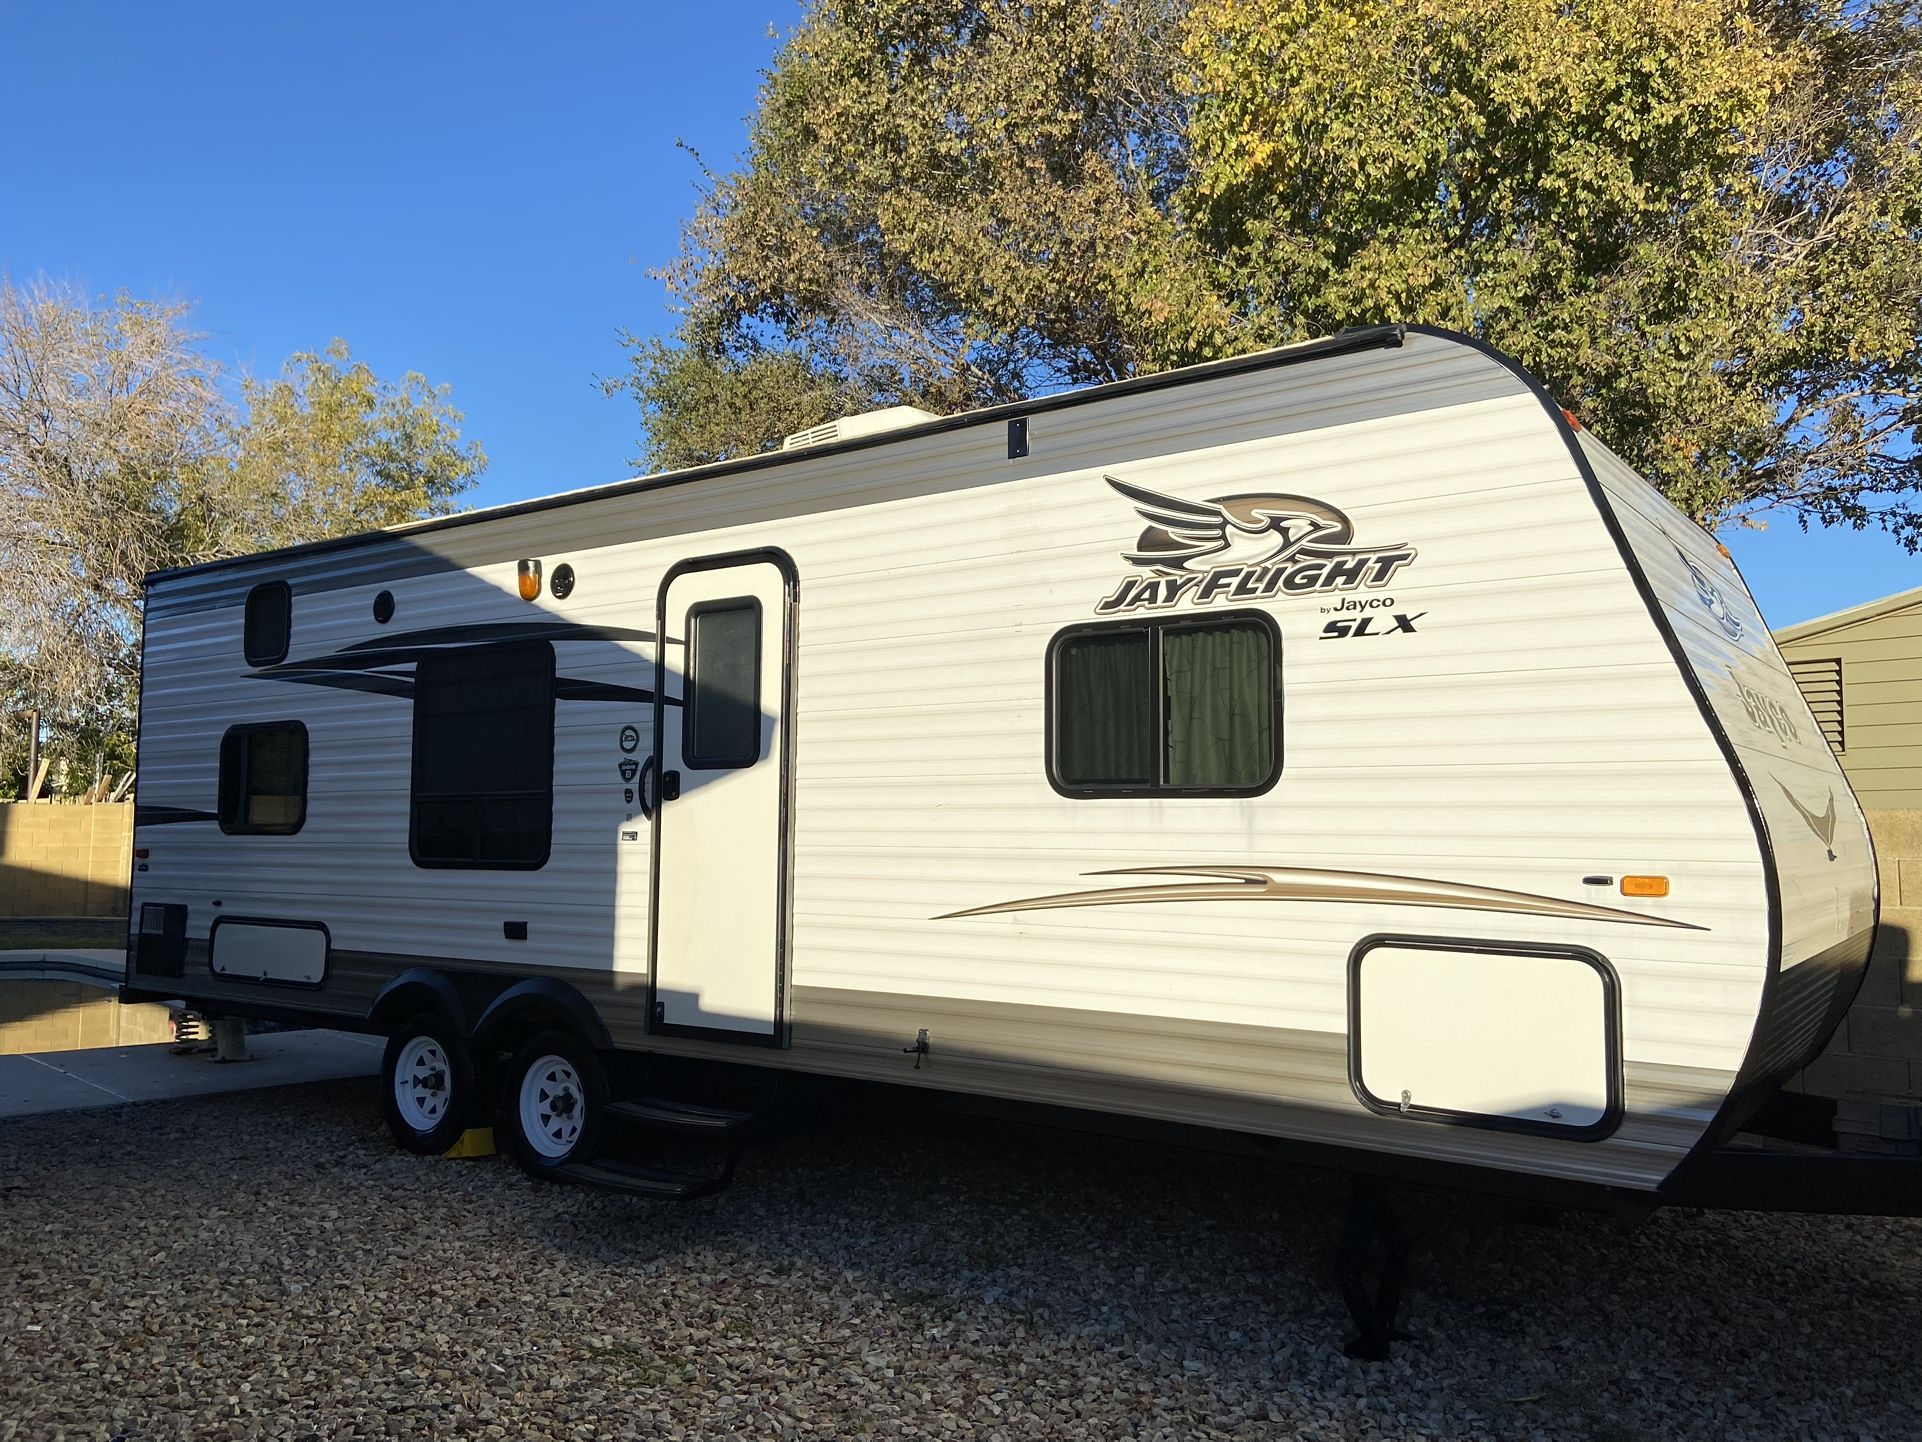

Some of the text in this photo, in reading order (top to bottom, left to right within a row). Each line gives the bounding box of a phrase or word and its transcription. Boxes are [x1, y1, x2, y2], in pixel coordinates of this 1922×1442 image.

[1095, 549, 1416, 614] JAY FLIGHT
[1320, 597, 1395, 614] by Jayco
[1319, 611, 1429, 640] SLX
